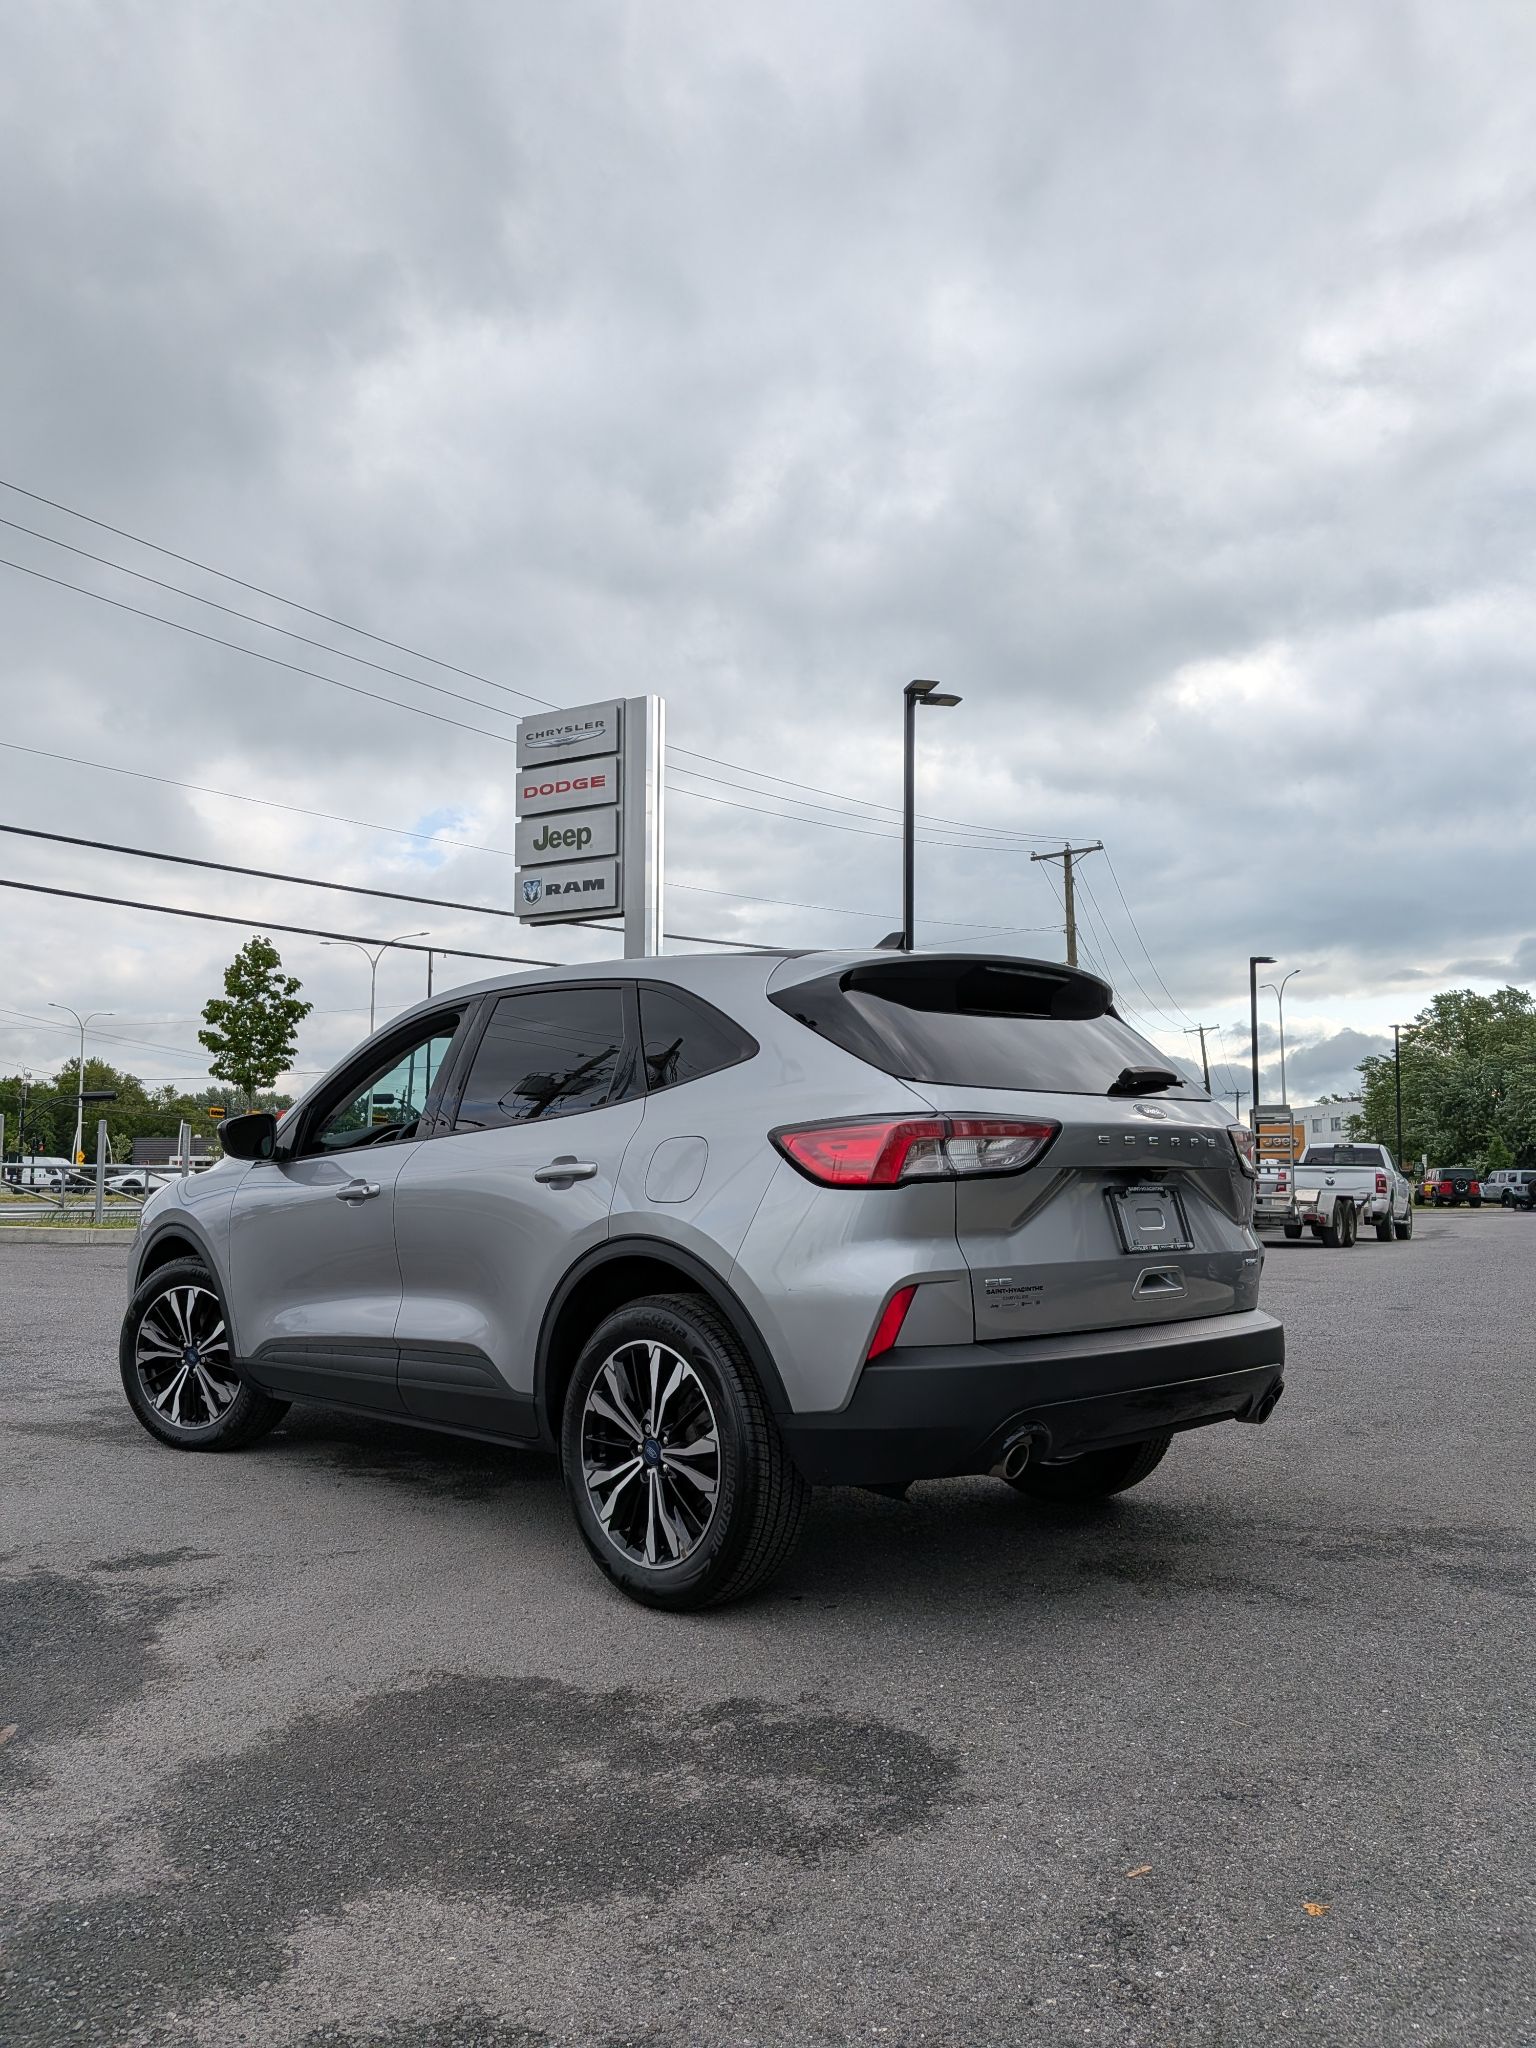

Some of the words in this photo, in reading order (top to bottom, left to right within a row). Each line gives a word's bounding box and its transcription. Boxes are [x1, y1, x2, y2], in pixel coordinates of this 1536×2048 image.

[526, 720, 605, 741] CHRYSLER
[523, 775, 606, 799] DODGE
[533, 825, 592, 851] Jeep
[545, 878, 605, 896] RAM
[1098, 1135, 1216, 1147] ESCAPE
[984, 1277, 1013, 1287] SE
